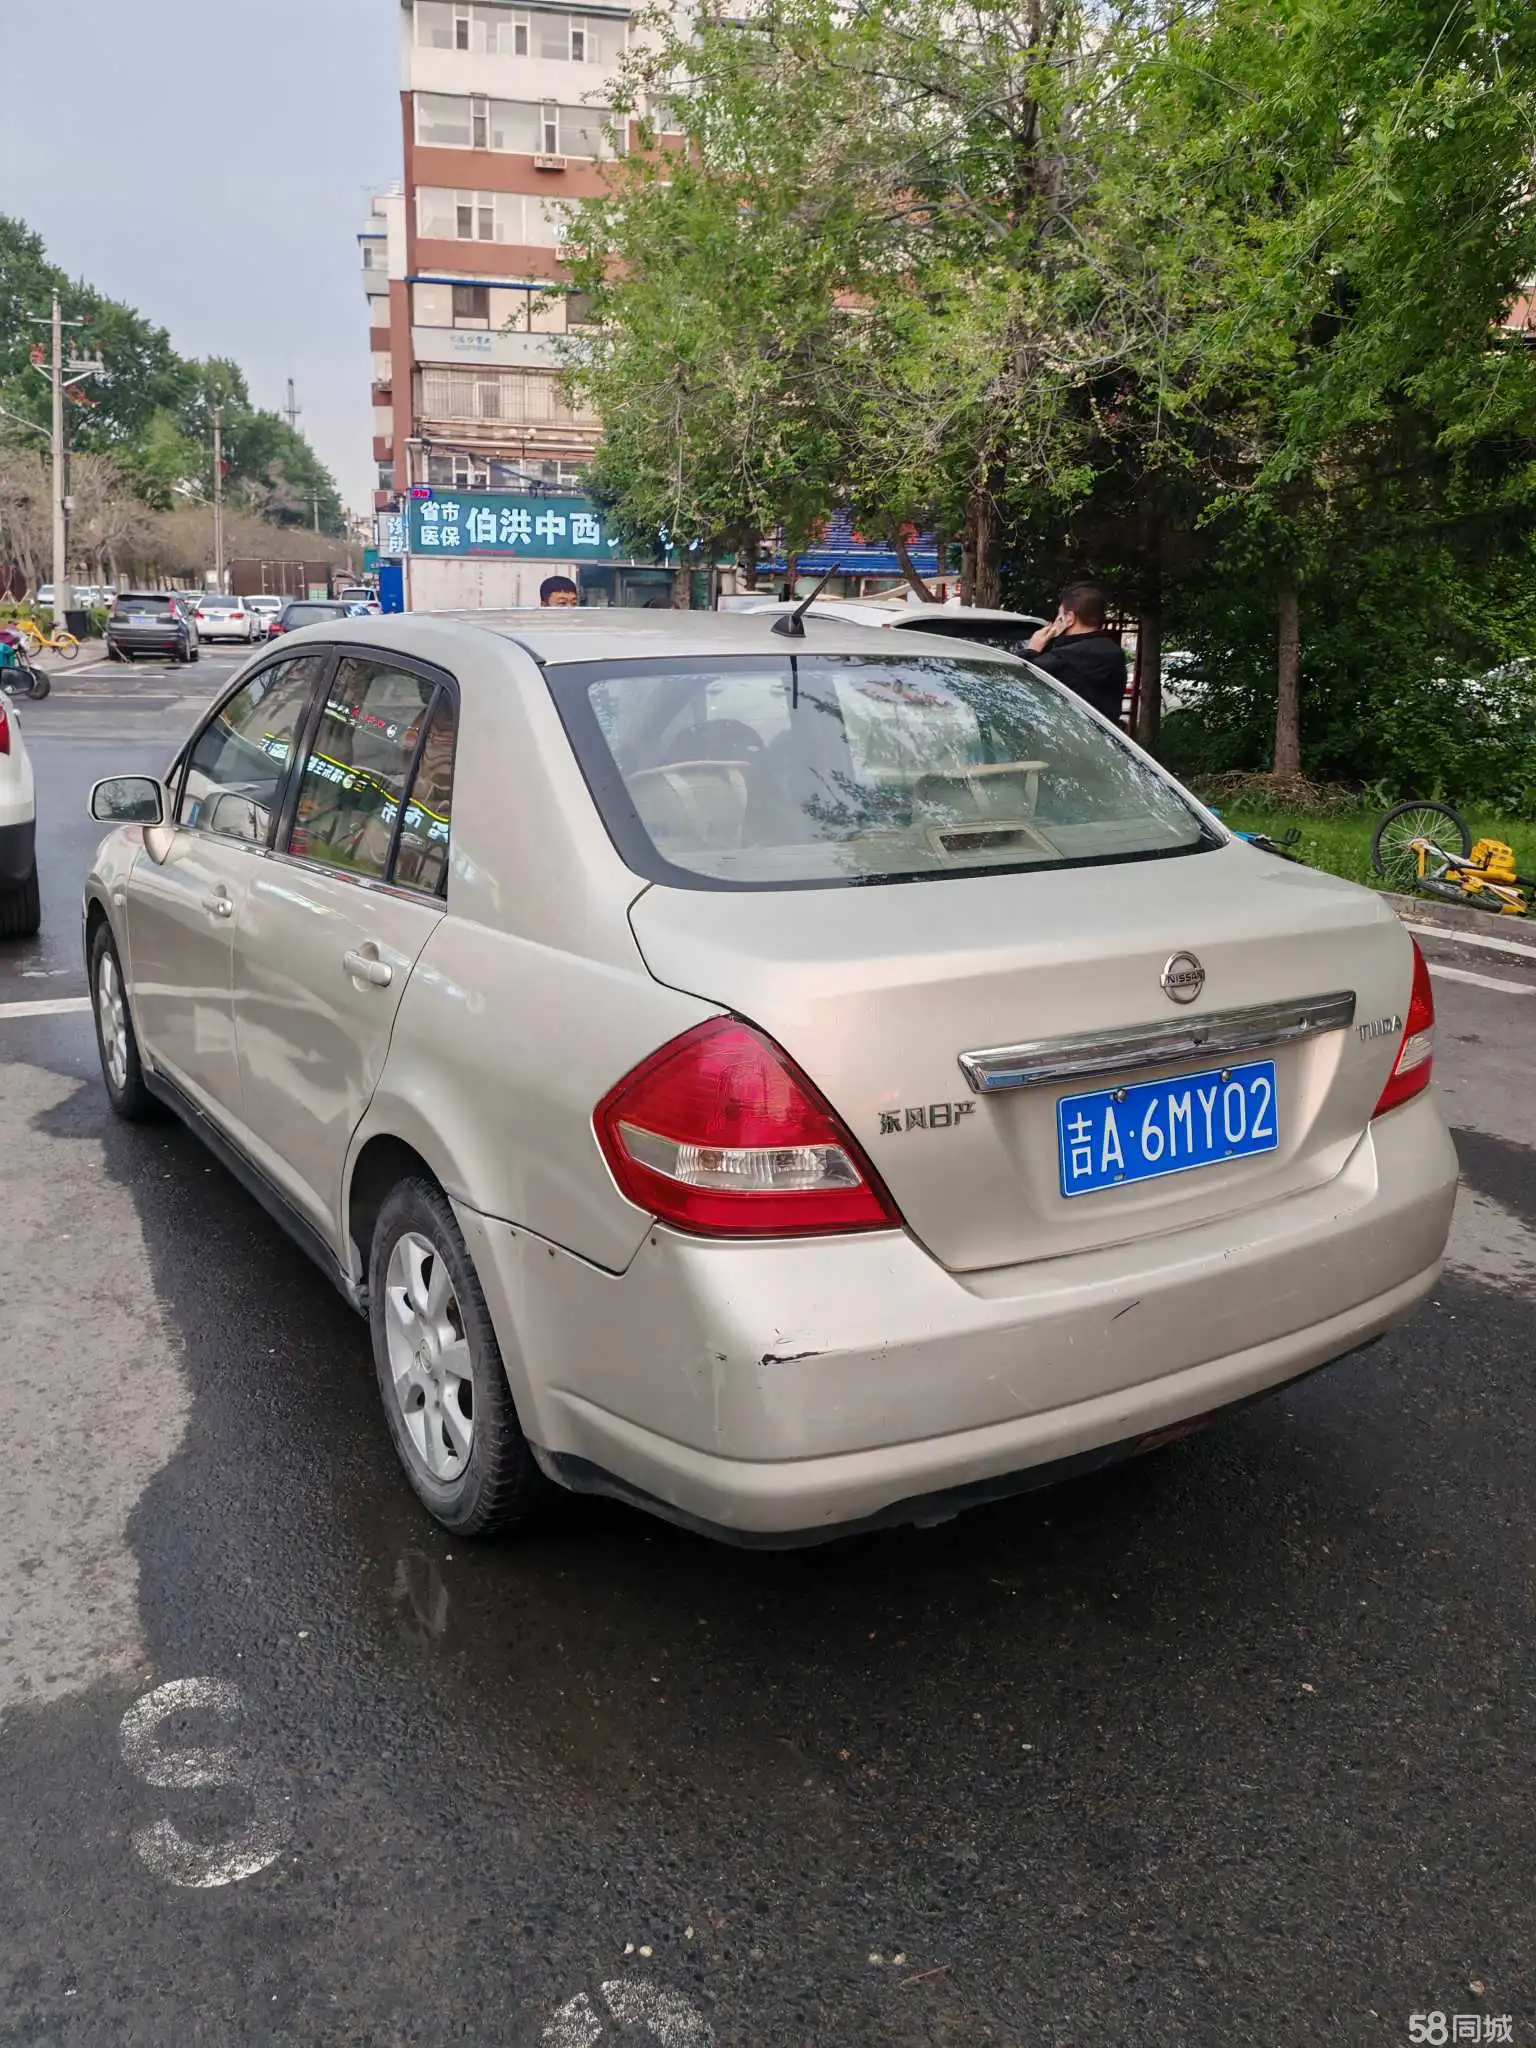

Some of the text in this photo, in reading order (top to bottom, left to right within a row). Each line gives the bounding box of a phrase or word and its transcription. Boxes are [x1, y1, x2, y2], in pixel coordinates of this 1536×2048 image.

[420, 501, 460, 521] 省市
[420, 525, 461, 546] 医保
[1166, 969, 1204, 985] NISSAN
[1359, 1015, 1402, 1041] TIIDA
[878, 1100, 977, 1135] 东风日产
